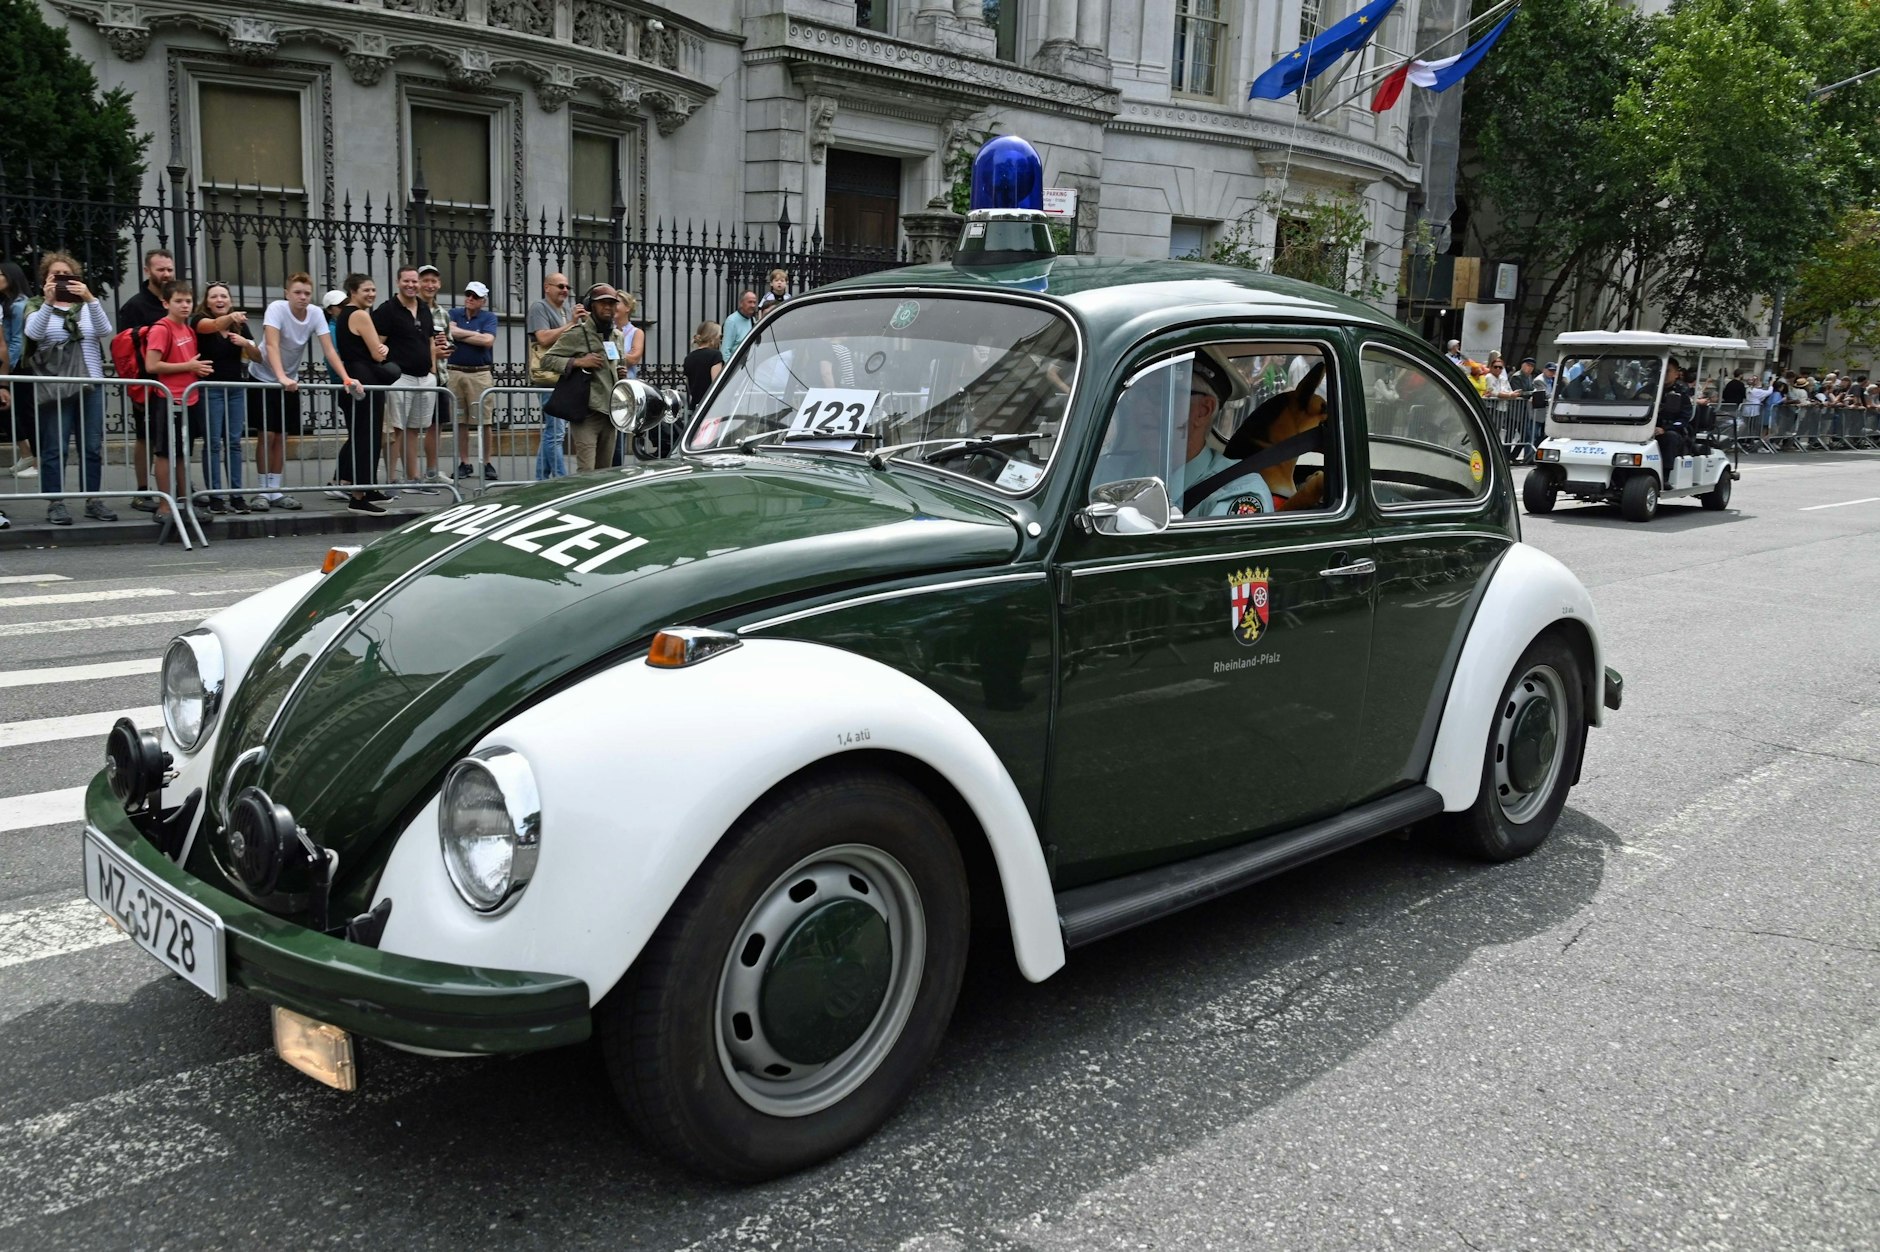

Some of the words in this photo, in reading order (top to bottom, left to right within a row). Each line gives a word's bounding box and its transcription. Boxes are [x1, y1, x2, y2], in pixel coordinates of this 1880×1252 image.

[803, 401, 865, 432] 123
[401, 503, 649, 574] POLIZEI
[1213, 652, 1281, 673] Rheinland-Pfalz
[837, 732, 852, 746] 1,4
[855, 728, 871, 742] atü
